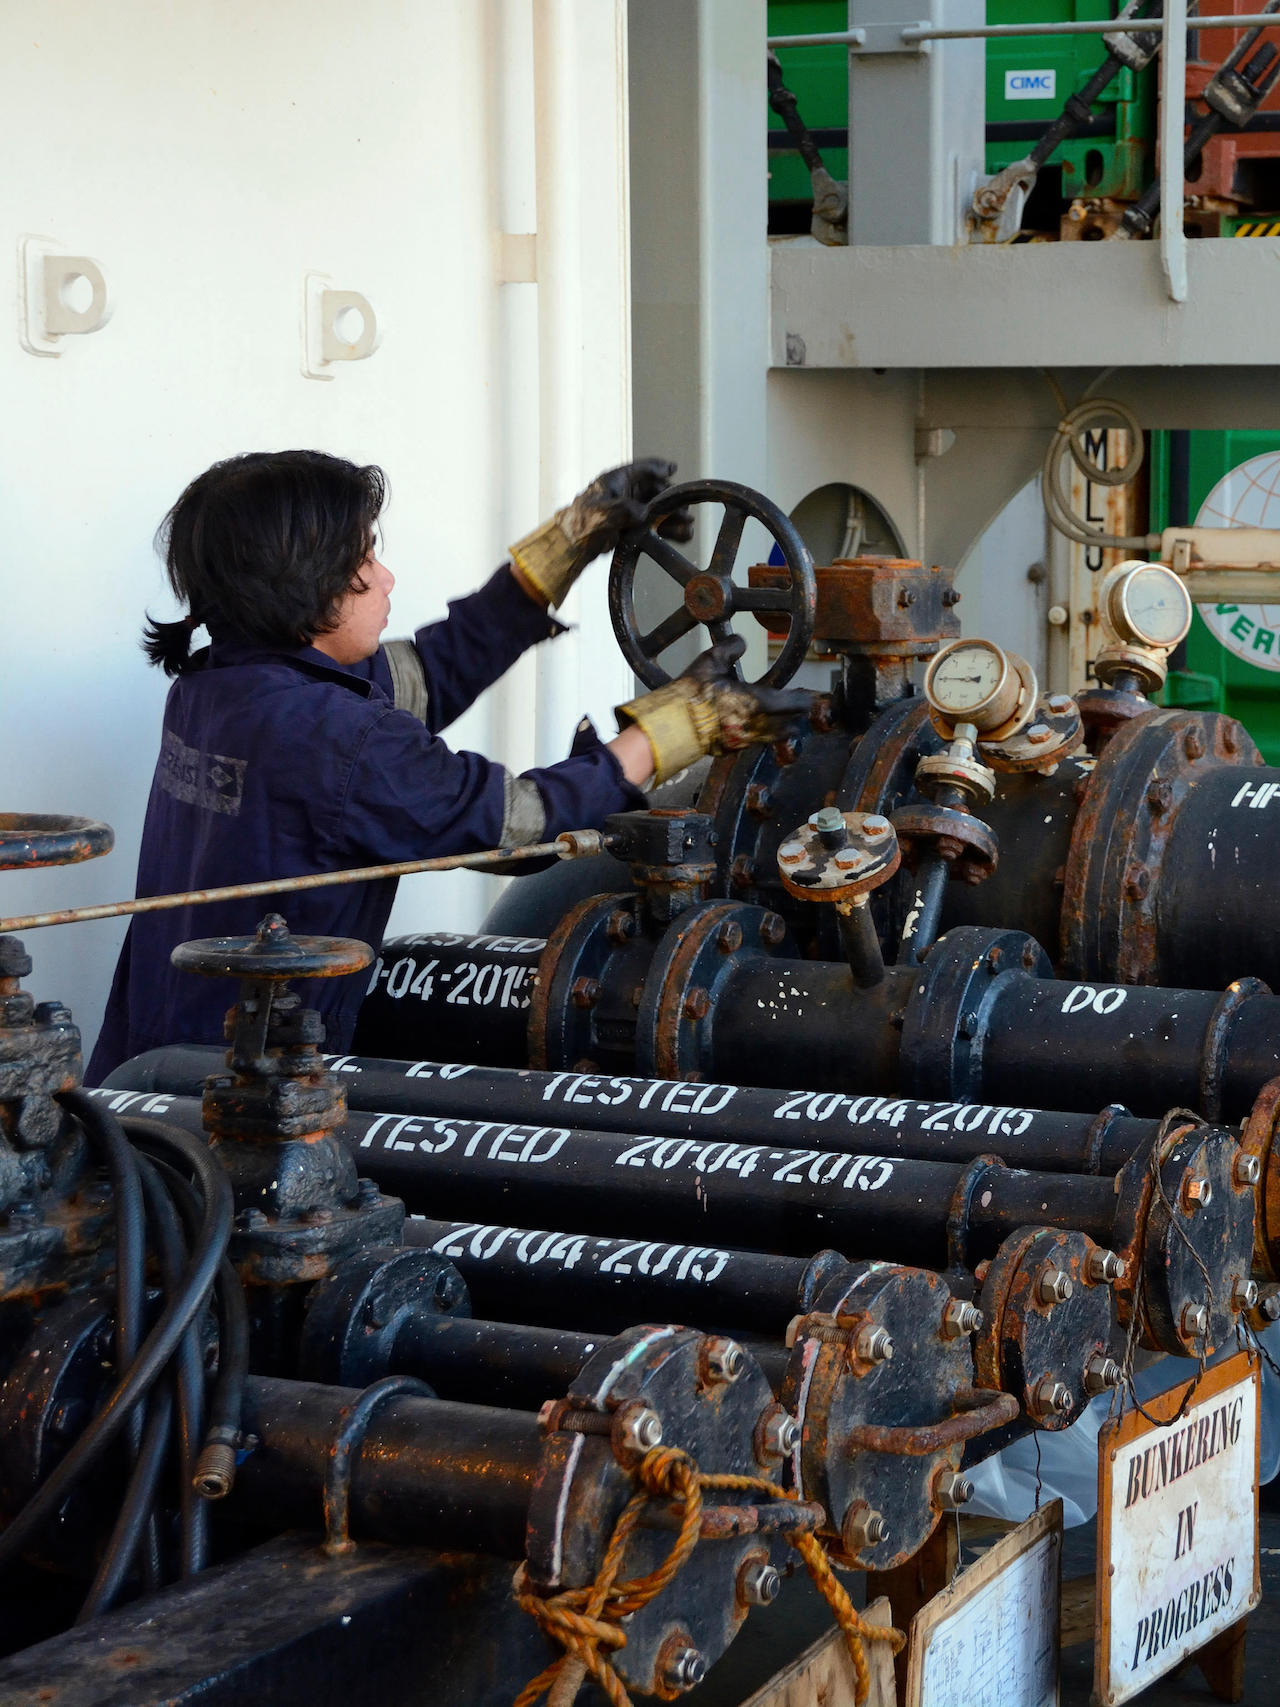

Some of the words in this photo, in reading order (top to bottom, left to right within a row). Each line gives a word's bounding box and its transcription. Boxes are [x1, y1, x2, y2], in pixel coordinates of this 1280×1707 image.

[1010, 76, 1052, 90] CIMC
[1060, 986, 1127, 1015] DO
[542, 1071, 739, 1116] TESTED
[773, 1090, 1042, 1137] 20-04-2015
[359, 1113, 571, 1163] TESTED
[614, 1135, 905, 1191] 20-04-2015
[432, 1222, 732, 1283] 20-04-2015
[1124, 1396, 1244, 1510] BUNKERING
[1173, 1501, 1199, 1561] IN
[1130, 1555, 1236, 1672] PROGRESS
